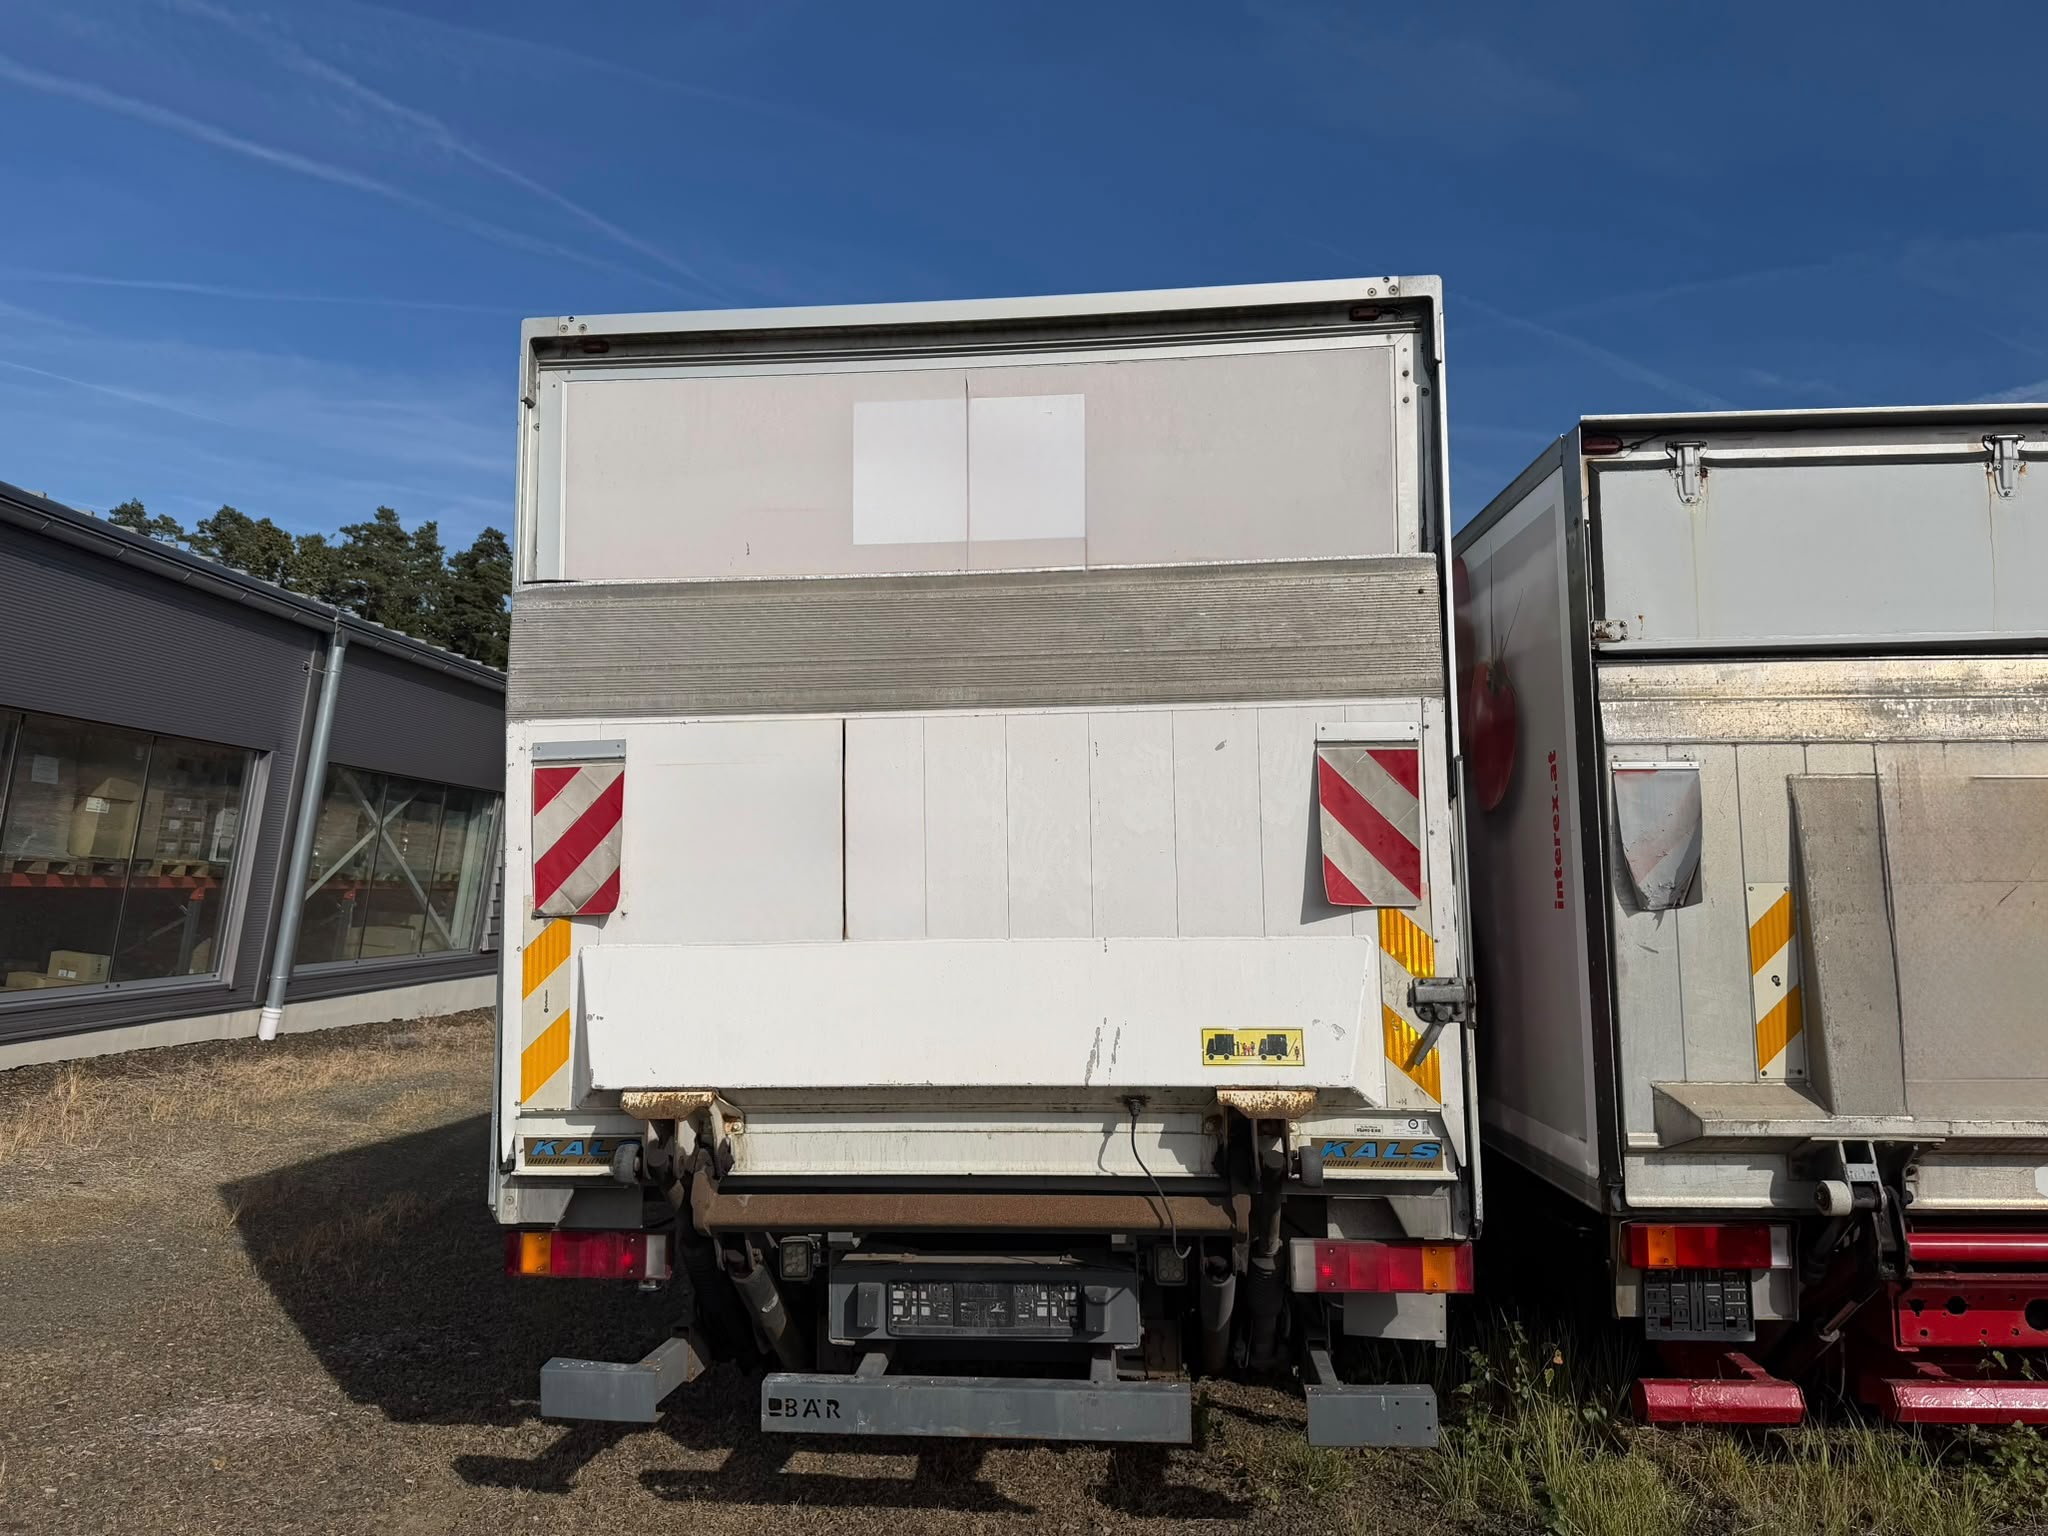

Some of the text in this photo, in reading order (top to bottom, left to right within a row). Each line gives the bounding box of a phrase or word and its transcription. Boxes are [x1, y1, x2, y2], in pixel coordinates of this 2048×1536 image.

[1548, 750, 1564, 910] interex.at
[531, 1140, 641, 1157] KAL
[1321, 1141, 1441, 1160] KALS
[785, 1398, 841, 1419] BÄR
